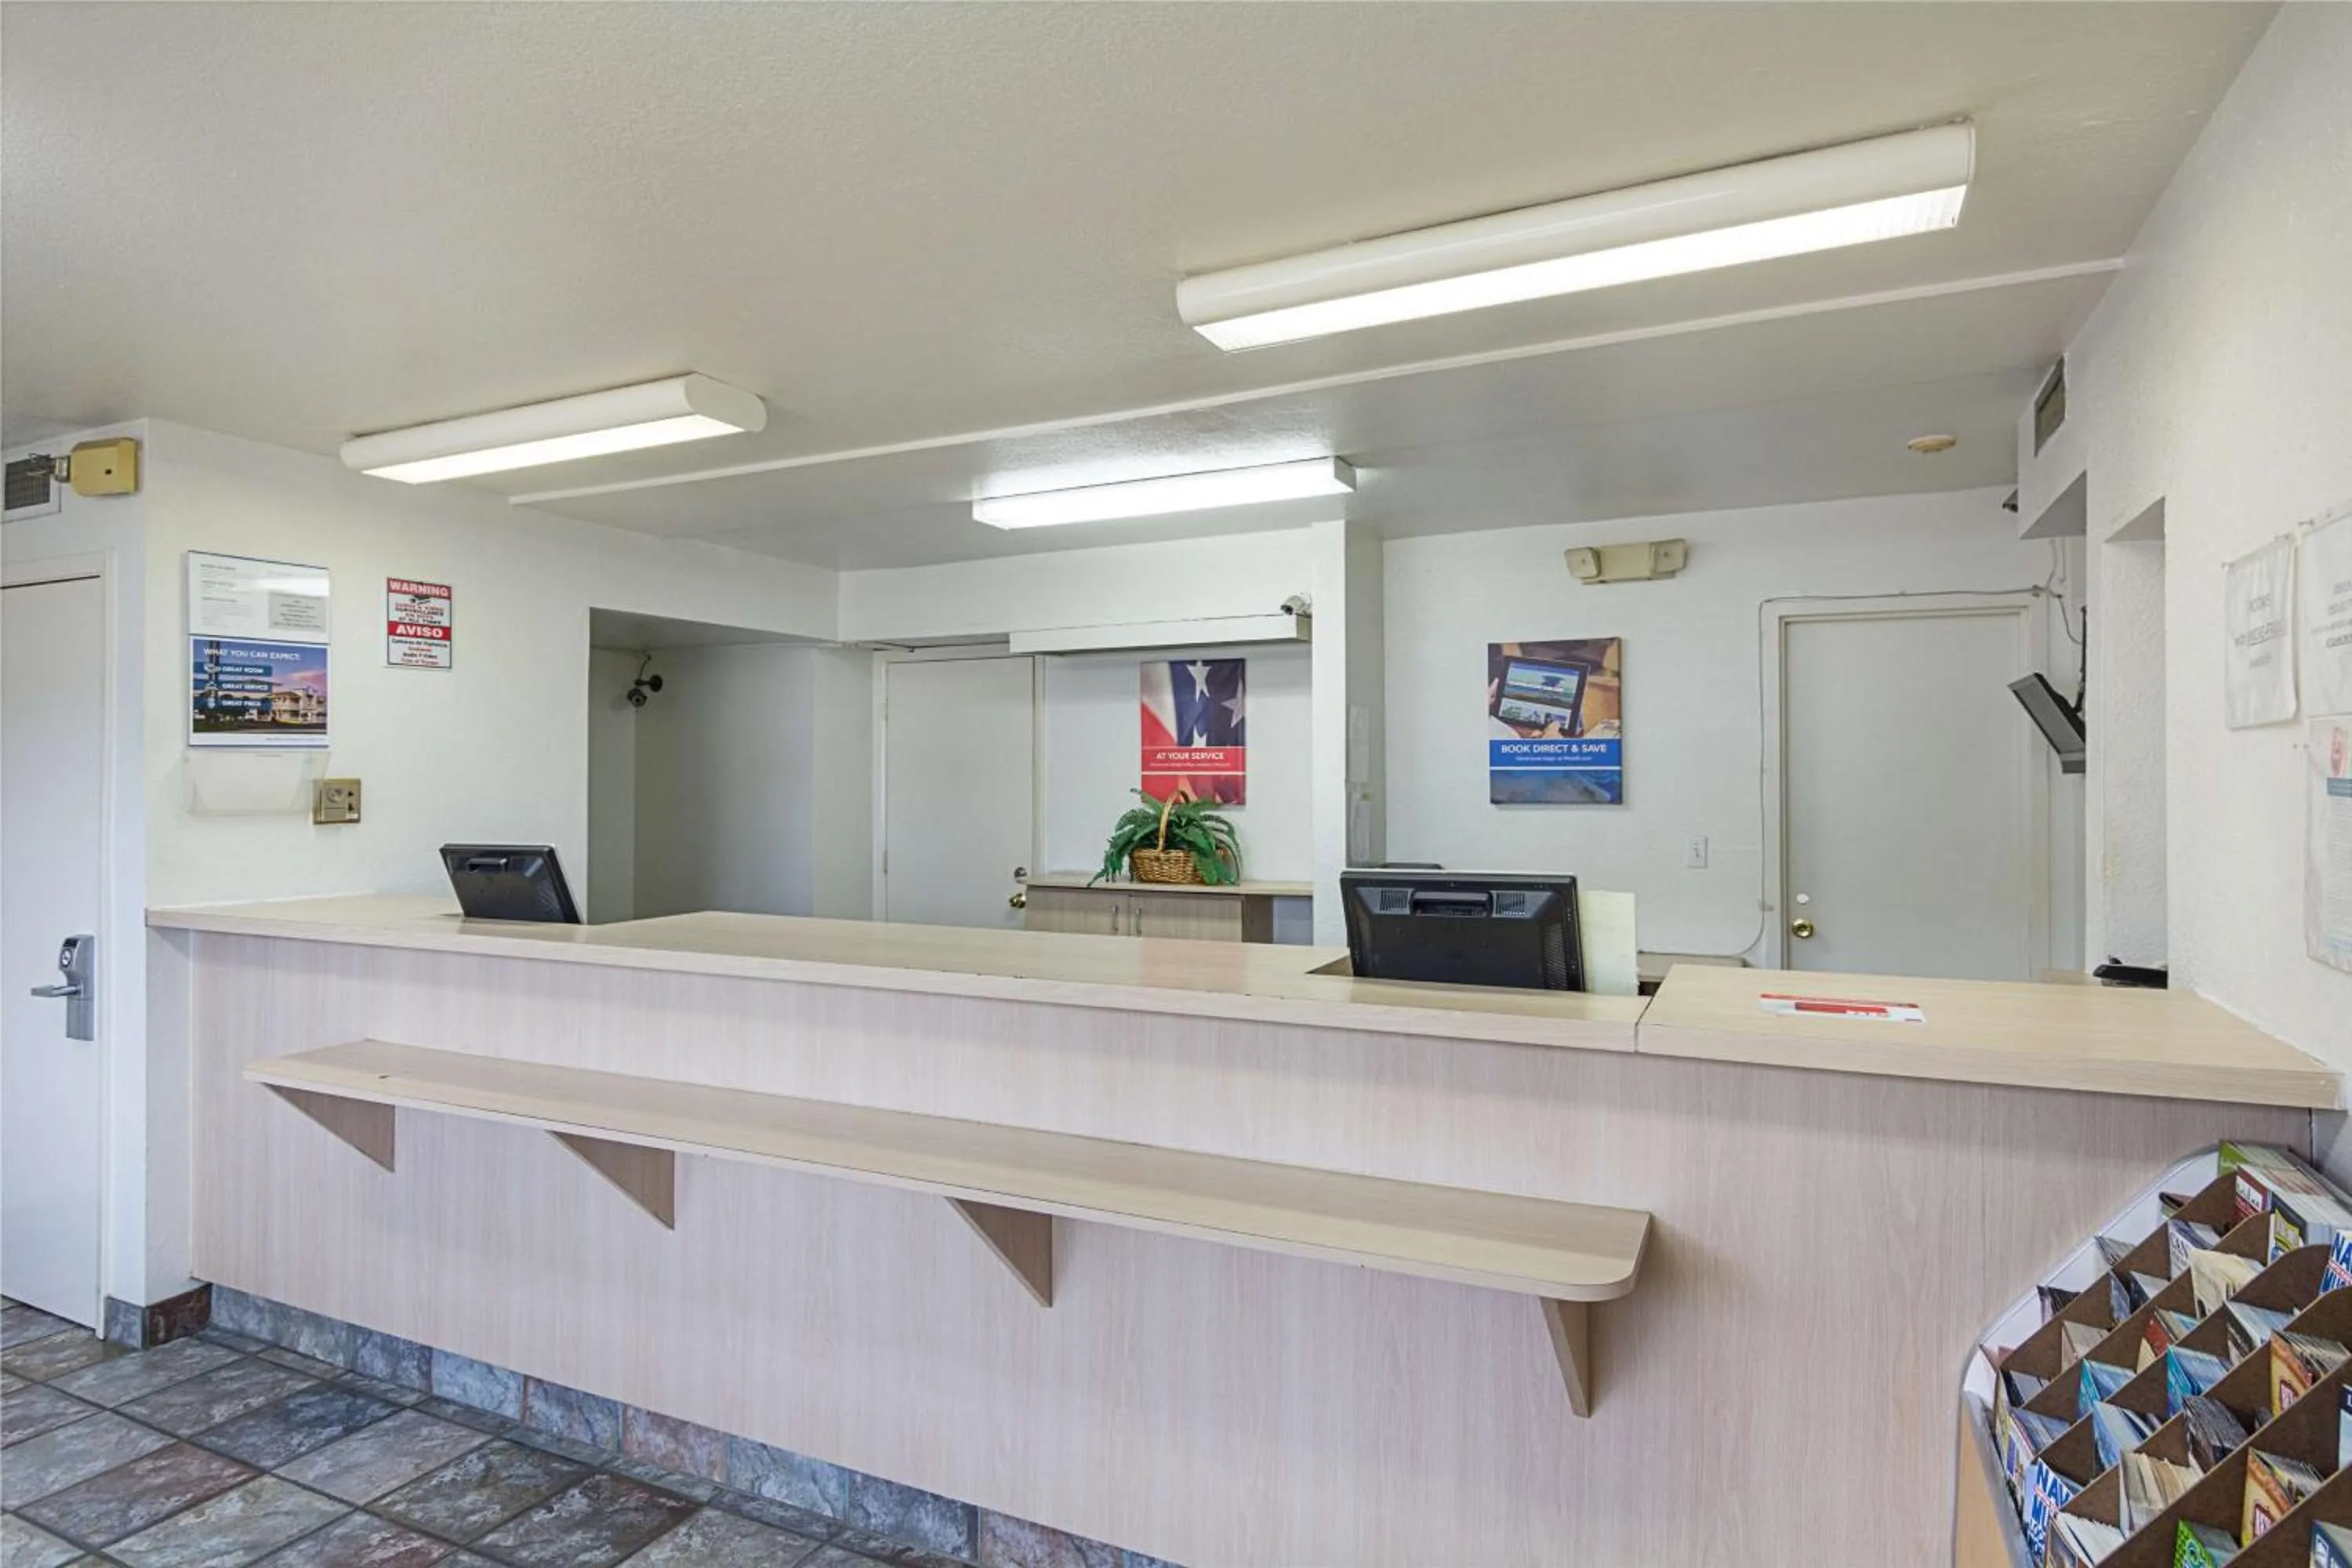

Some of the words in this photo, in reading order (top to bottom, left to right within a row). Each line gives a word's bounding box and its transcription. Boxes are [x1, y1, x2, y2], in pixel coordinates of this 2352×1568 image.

[390, 580, 449, 597] WARNING
[396, 624, 444, 638] AVISO
[250, 651, 268, 659] CAN
[1501, 744, 1530, 753] BOOK
[1533, 744, 1568, 753] DIRECT
[1570, 744, 1579, 753] &
[1581, 744, 1607, 753] SAVE
